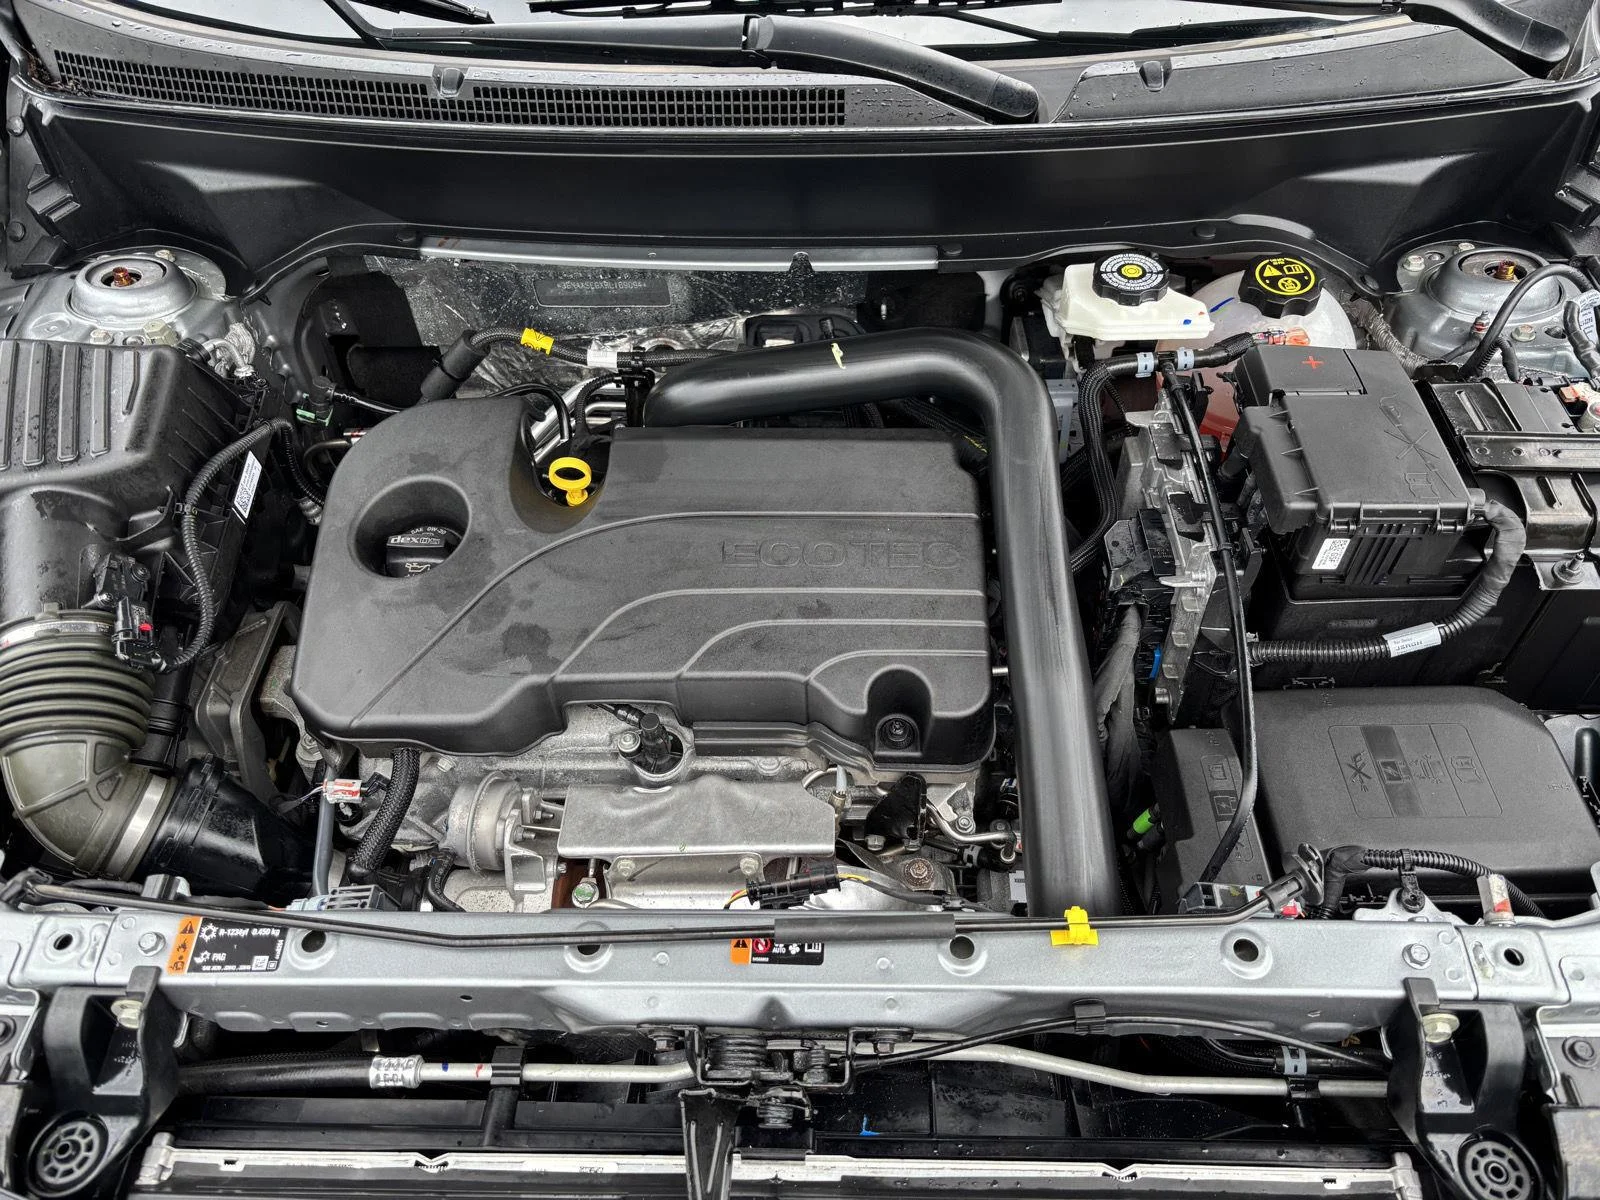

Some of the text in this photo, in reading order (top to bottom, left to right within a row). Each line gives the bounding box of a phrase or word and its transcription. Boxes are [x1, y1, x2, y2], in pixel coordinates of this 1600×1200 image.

[721, 540, 962, 570] ECOTEC
[218, 927, 281, 938] R-1234yf 0.450 kg
[772, 946, 786, 954] AUTO
[211, 952, 227, 961] PAG
